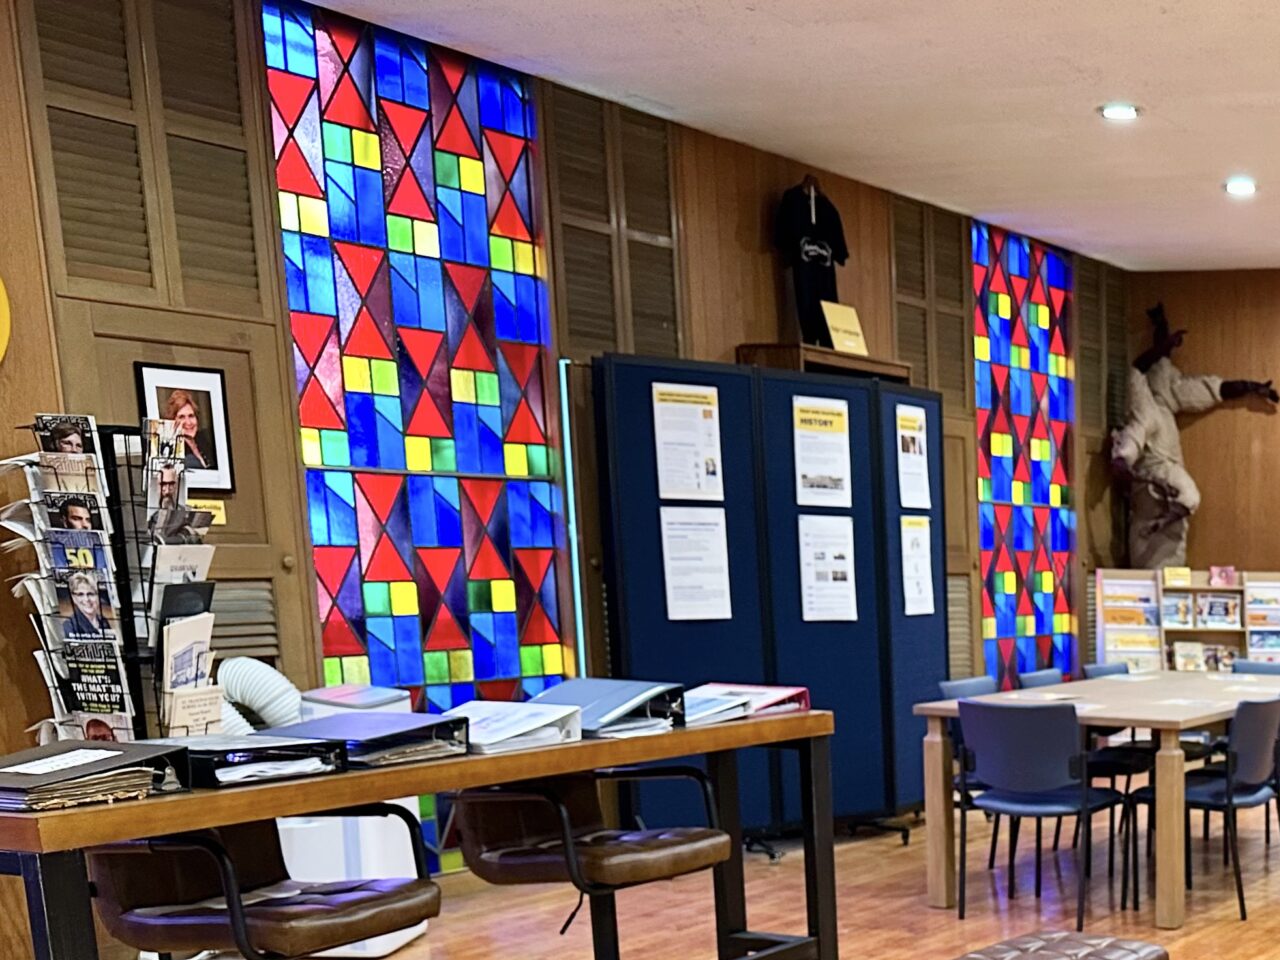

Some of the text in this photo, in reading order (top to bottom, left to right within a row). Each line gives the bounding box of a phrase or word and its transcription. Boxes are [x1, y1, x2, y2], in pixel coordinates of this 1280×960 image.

[800, 418, 833, 427] HISTORY
[65, 547, 95, 568] 50
[71, 682, 88, 692] THE
